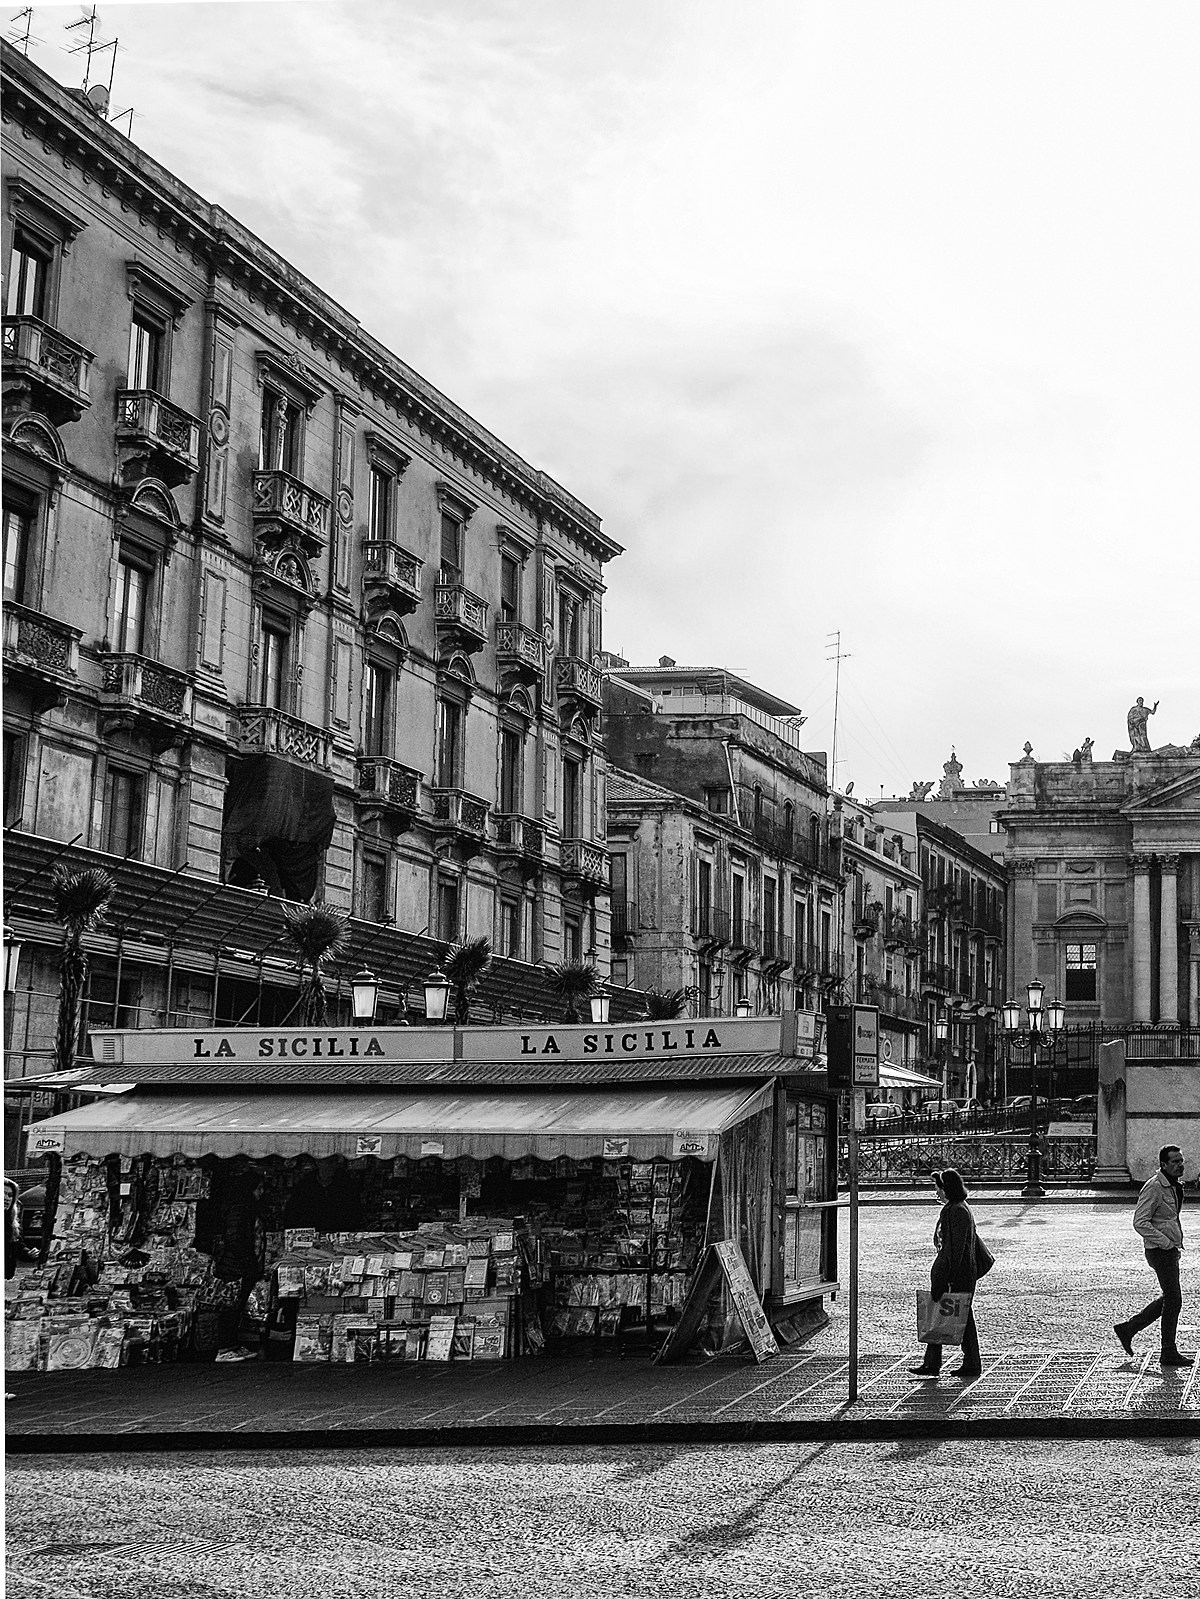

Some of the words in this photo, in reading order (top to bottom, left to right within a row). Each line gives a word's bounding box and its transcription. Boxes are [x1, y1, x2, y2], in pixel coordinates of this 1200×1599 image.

[194, 1038, 236, 1057] LA
[258, 1037, 386, 1057] SICILIA
[521, 1035, 561, 1055] LA
[583, 1028, 722, 1053] SICILIA
[939, 1298, 960, 1317] Si
